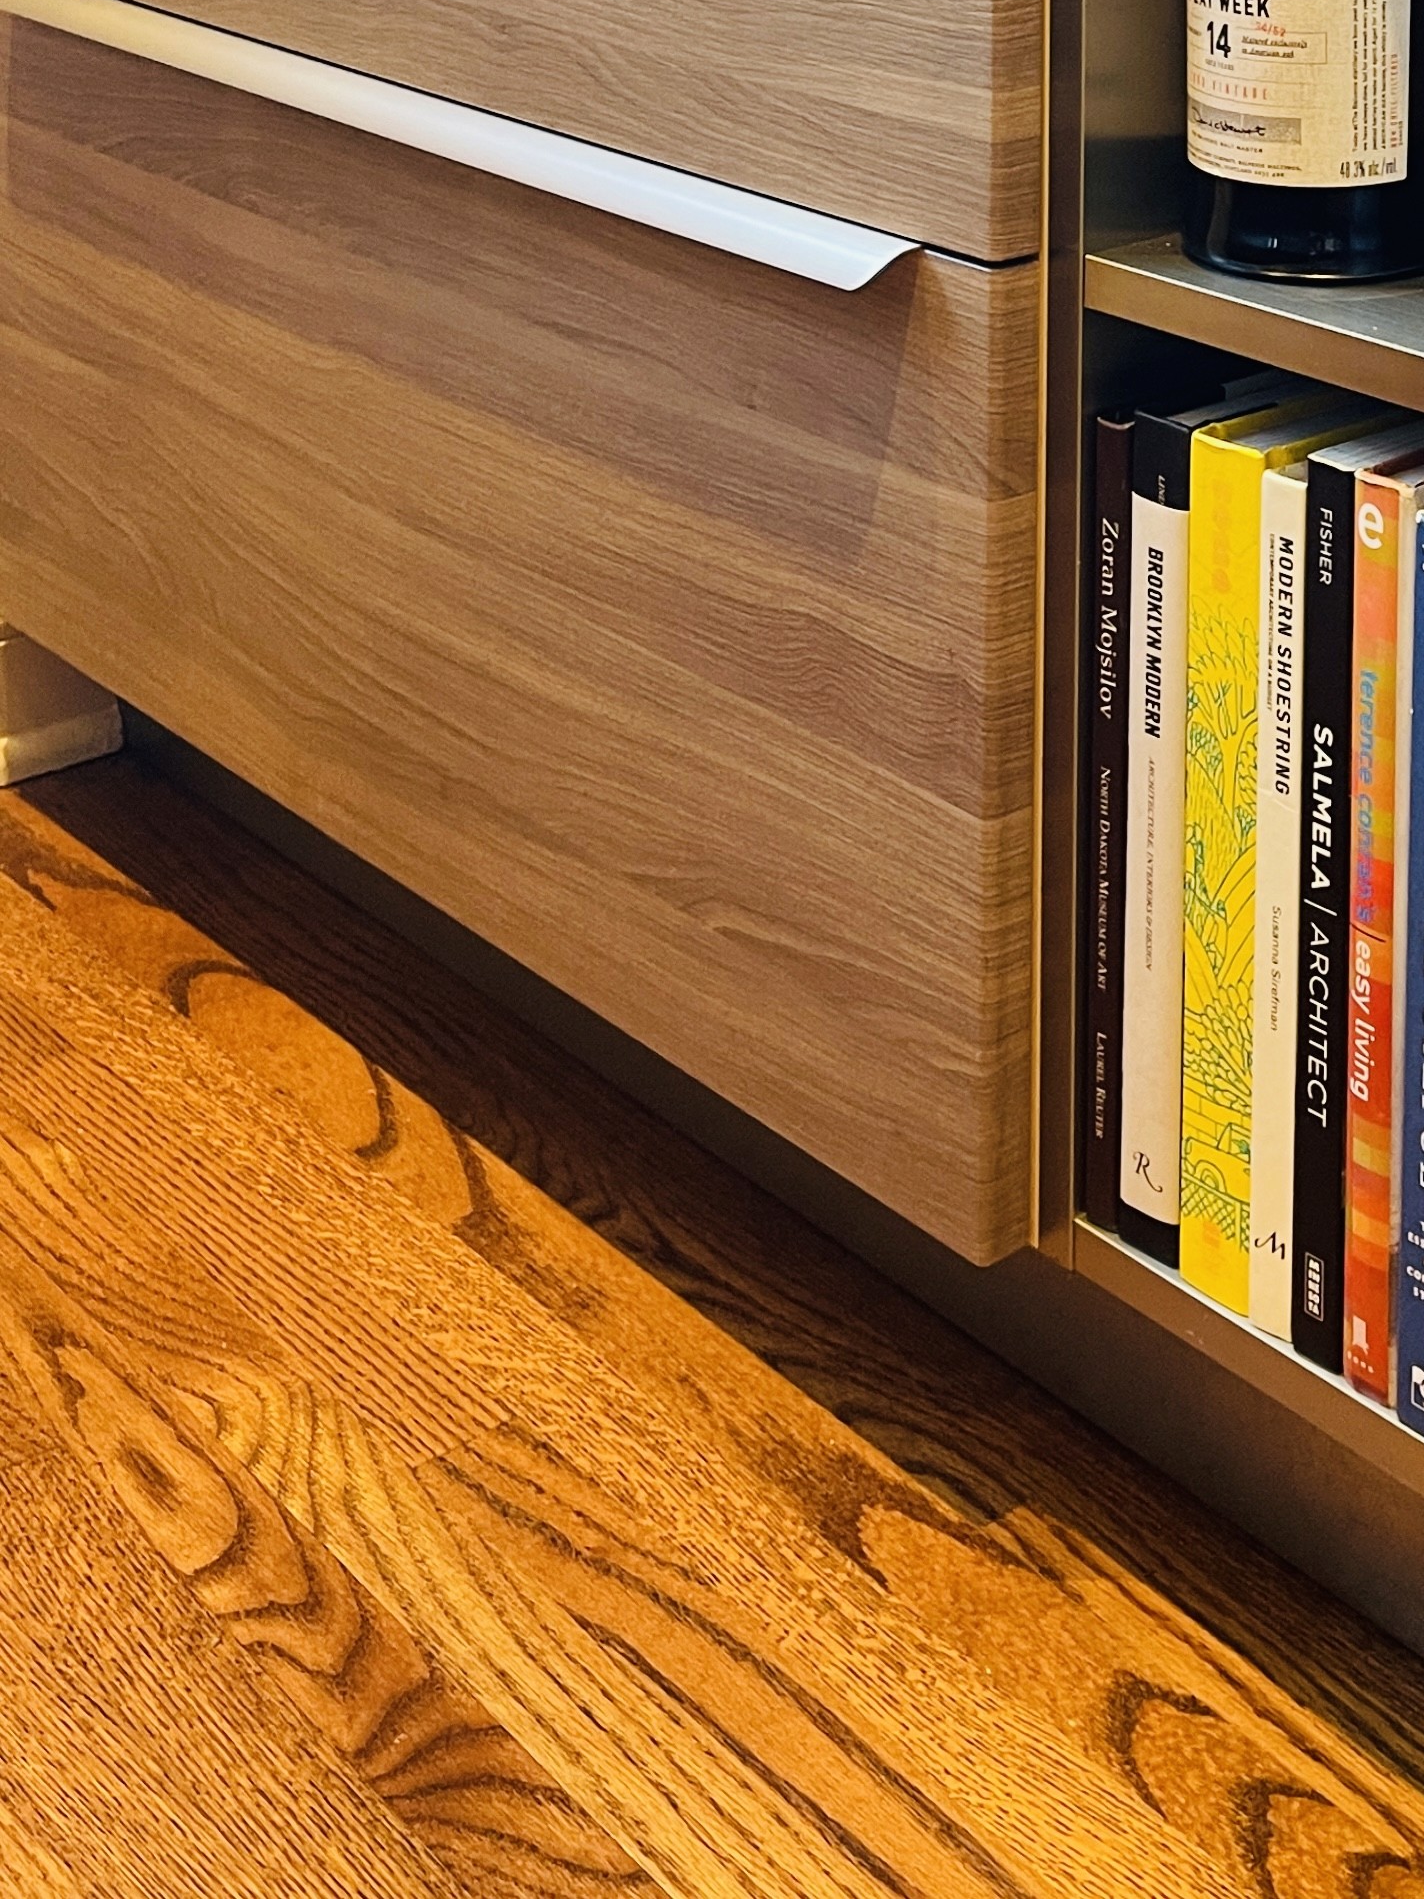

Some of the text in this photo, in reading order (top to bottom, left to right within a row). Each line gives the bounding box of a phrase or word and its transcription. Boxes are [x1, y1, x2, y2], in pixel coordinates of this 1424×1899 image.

[1207, 21, 1231, 58] 14
[1318, 507, 1333, 587] FISHER
[1357, 501, 1384, 550] e
[1095, 517, 1120, 721] Zoran Mojsilov
[1144, 546, 1164, 739] BROOKLYN MODERN
[1275, 536, 1294, 796] MODERN SHOESTRING
[1311, 723, 1333, 889] SALMELA
[1357, 669, 1379, 923] terence conran's
[1271, 905, 1282, 1031] Susanna Sirefman
[1307, 921, 1330, 1128] ARCHITECT
[1350, 940, 1376, 1102] easy living
[1132, 1151, 1163, 1193] R
